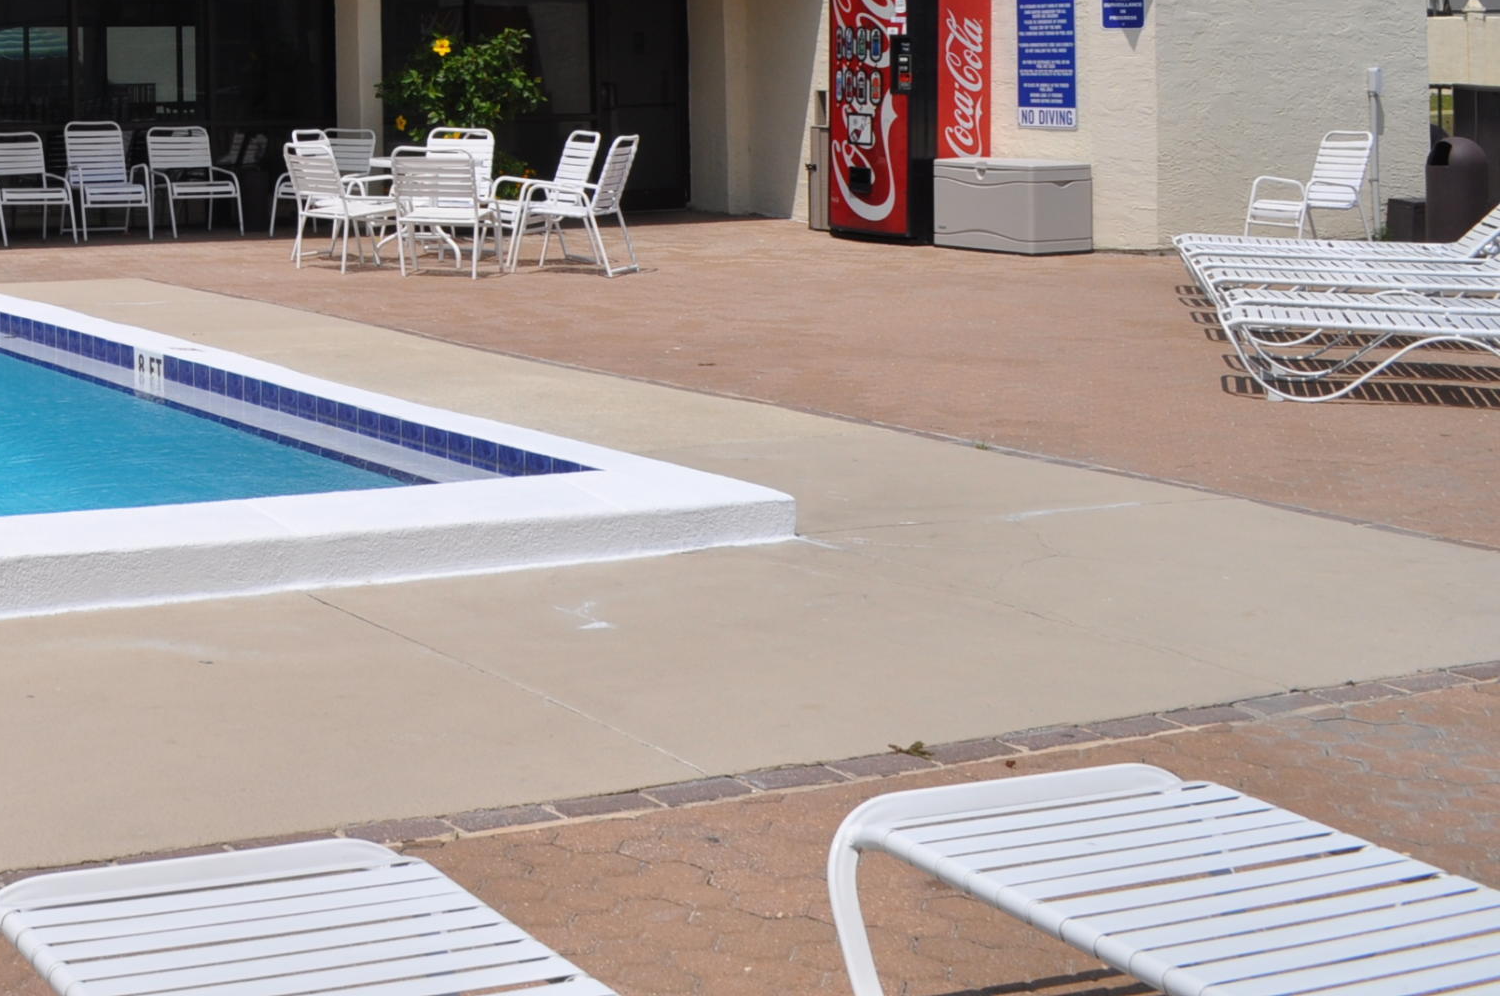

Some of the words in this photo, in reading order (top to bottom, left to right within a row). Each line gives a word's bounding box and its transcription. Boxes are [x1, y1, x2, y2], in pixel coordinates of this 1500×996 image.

[945, 8, 984, 158] Coca-Cola
[1021, 109, 1034, 124] NO
[1039, 109, 1073, 125] DIVING
